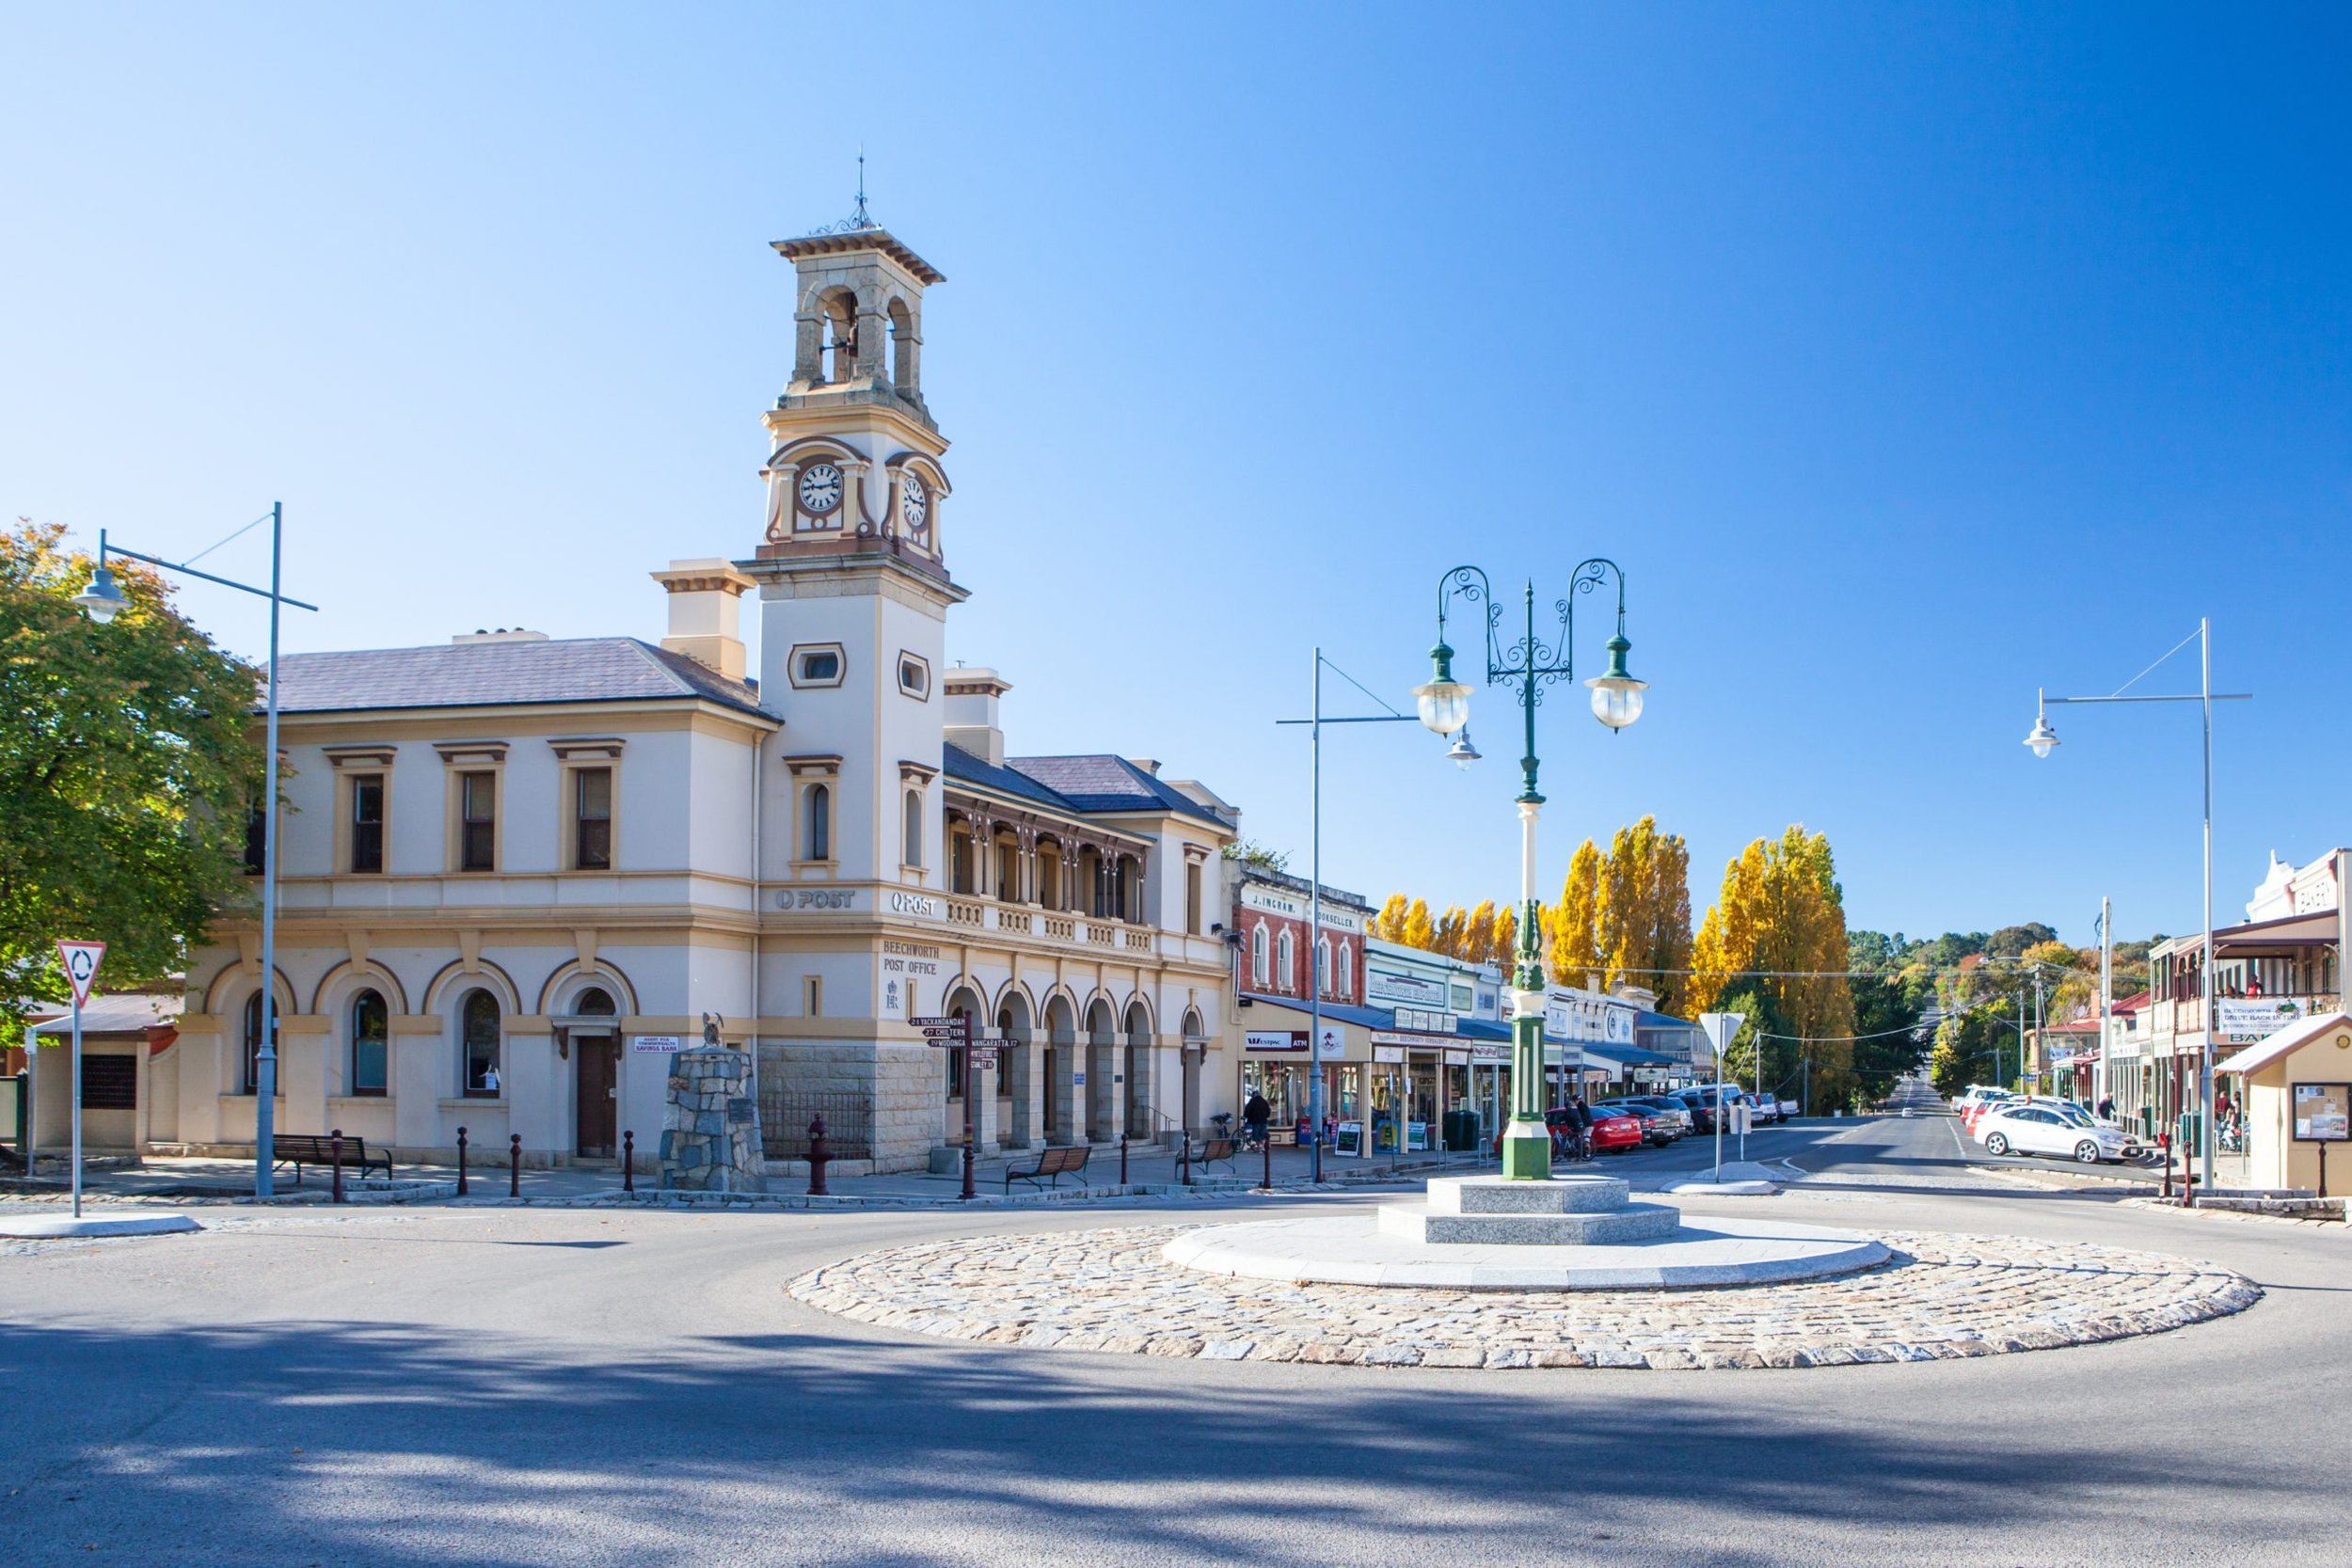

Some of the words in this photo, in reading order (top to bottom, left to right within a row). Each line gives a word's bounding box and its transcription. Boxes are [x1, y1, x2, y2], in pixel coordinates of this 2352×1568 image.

[799, 890, 855, 909] POST
[904, 894, 936, 915] POST
[883, 941, 939, 958] BEECHWORTH
[884, 958, 904, 972] POST
[909, 960, 937, 975] OFFICE
[2230, 1033, 2273, 1042] BAK
